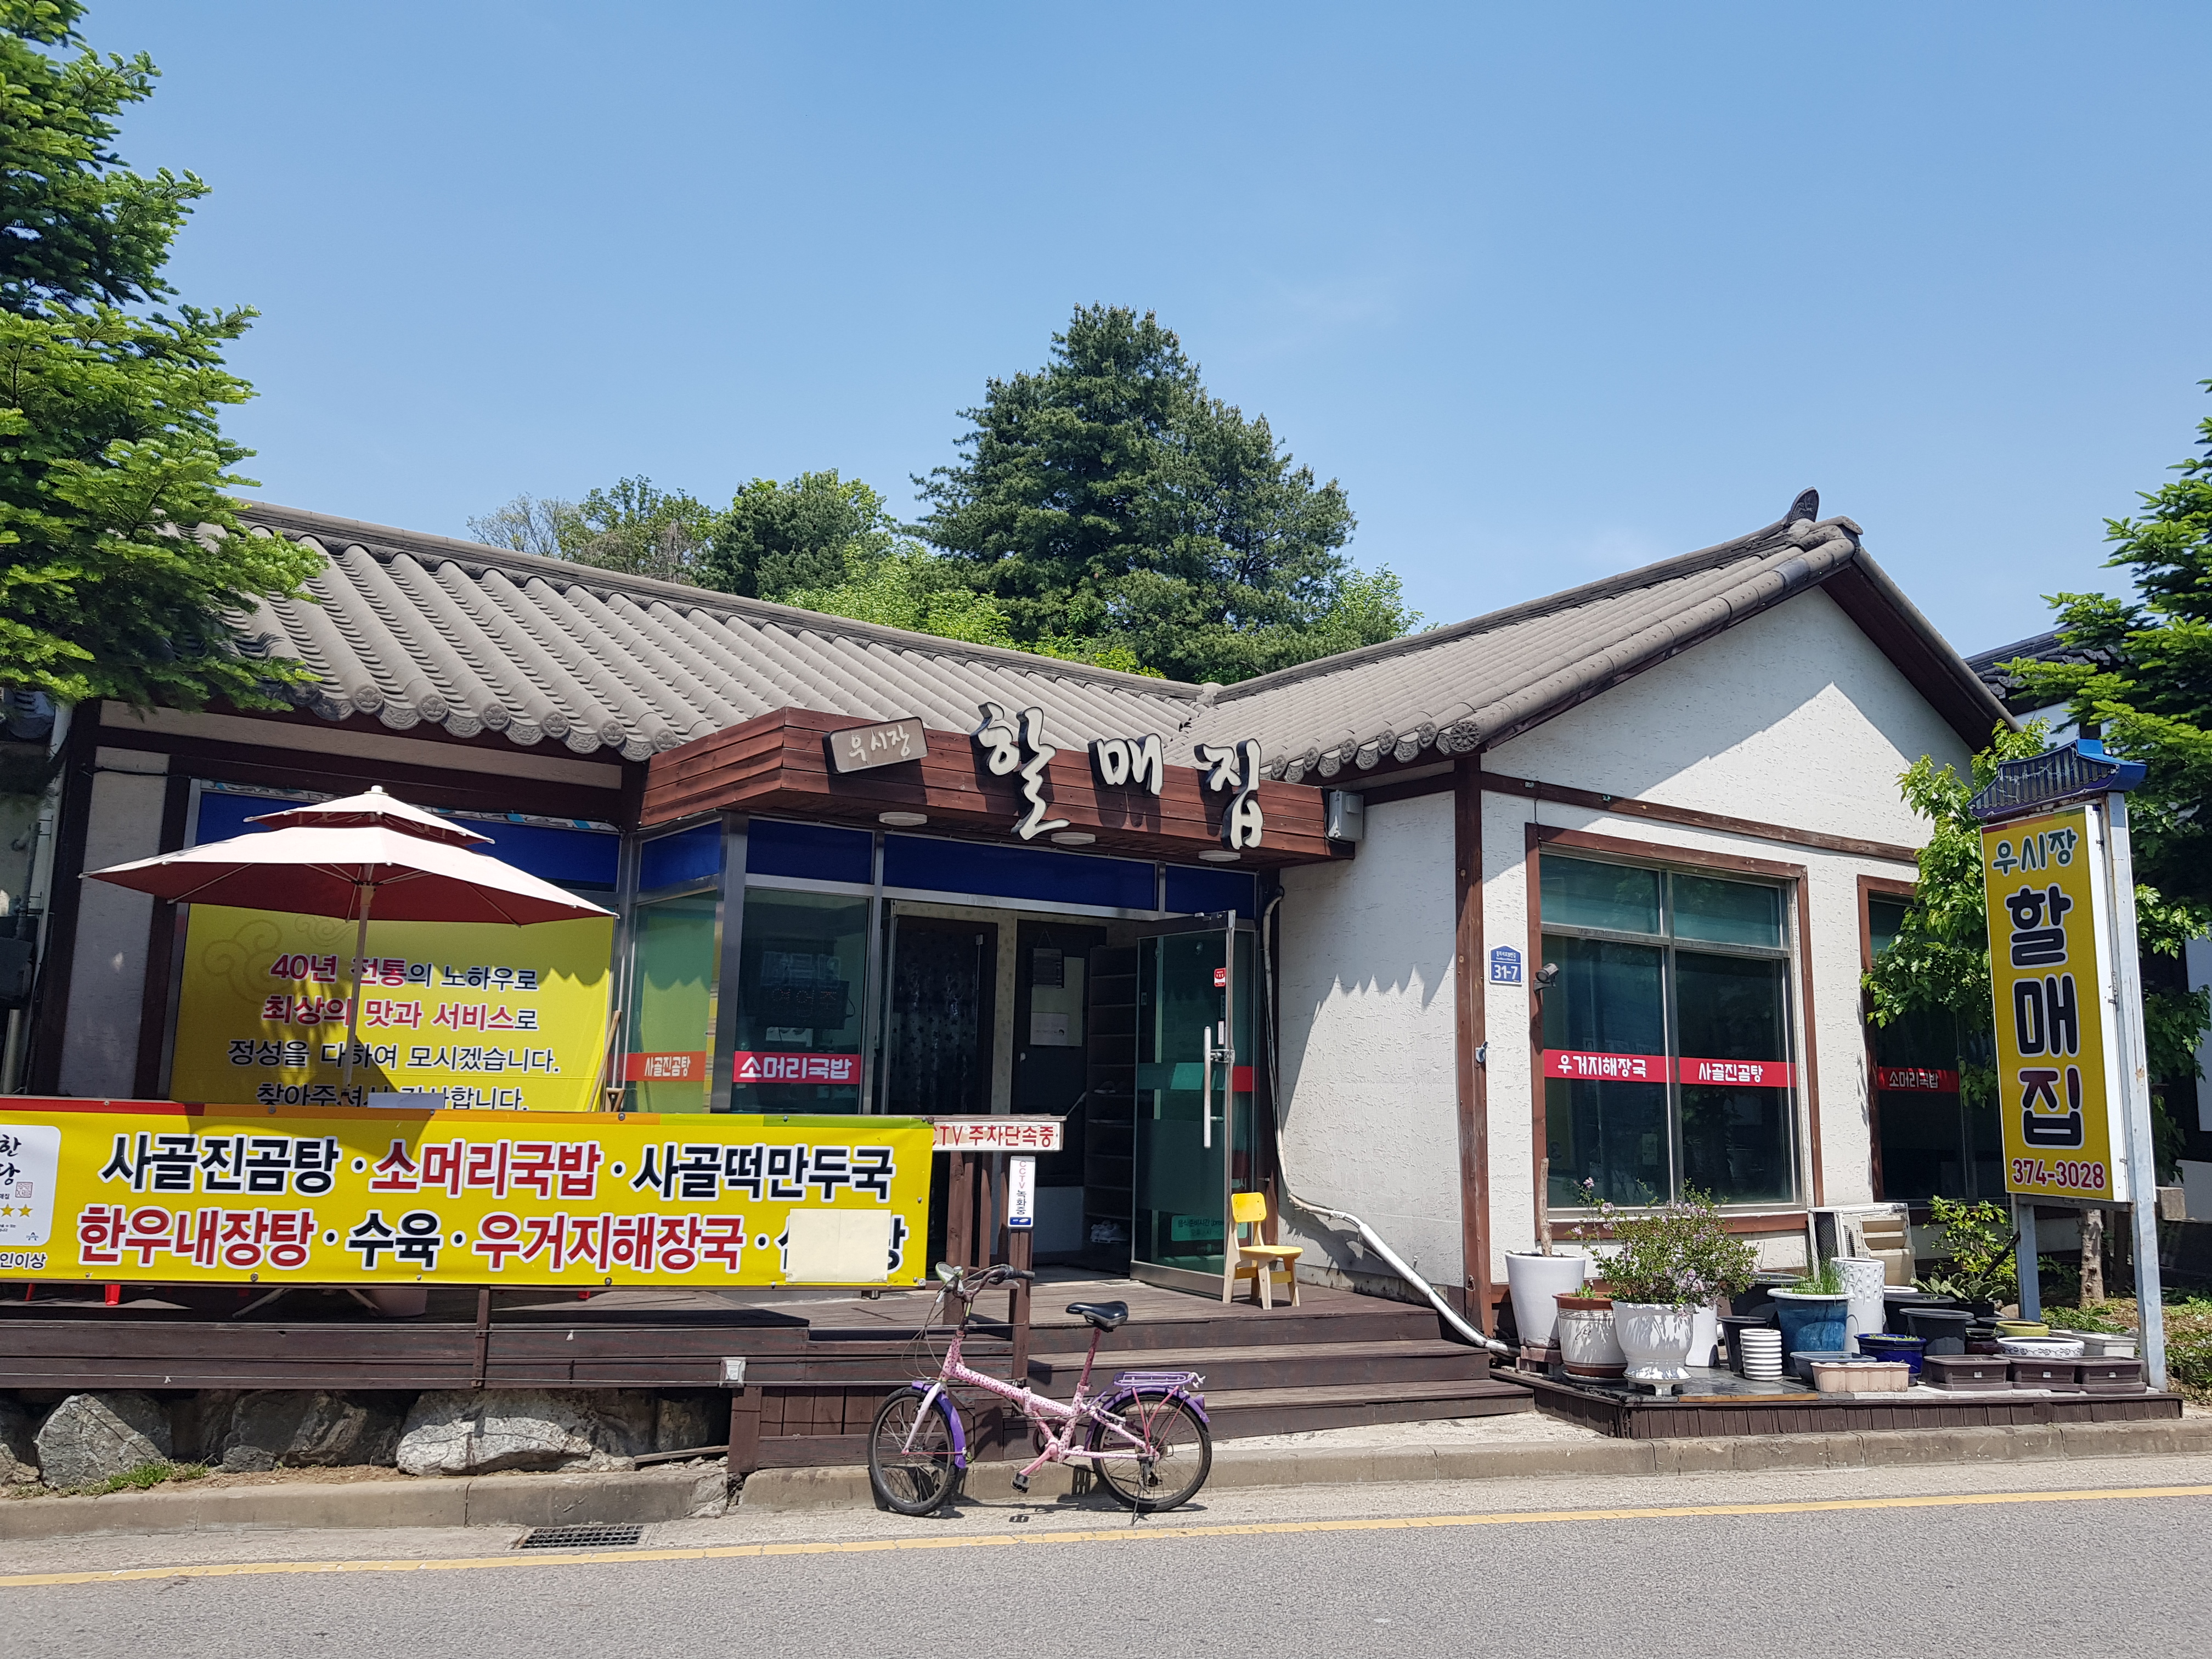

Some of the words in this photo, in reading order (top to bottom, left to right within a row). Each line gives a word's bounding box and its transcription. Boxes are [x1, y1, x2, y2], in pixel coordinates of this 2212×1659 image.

[848, 724, 912, 763] 우시장
[970, 702, 1265, 849] 할매집
[1992, 828, 2077, 874] 우시장
[270, 955, 337, 983] 40년
[441, 966, 538, 991] 노하우로
[1494, 964, 1518, 980] 31-7
[263, 995, 352, 1026] 최상의
[365, 1001, 422, 1029] 맛과
[433, 1003, 539, 1031] 서비스로
[2005, 884, 2083, 1148] 할매집
[228, 1040, 309, 1067] 정성을
[321, 1042, 397, 1069] 다하여
[408, 1047, 560, 1073] 모시겠습니다.
[644, 1056, 691, 1077] 사골진곰탕
[739, 1057, 853, 1080] 소머리국밥
[1558, 1054, 1647, 1079] 우거지해장국
[1698, 1062, 1764, 1084] 사골진곰탕
[1889, 1070, 1939, 1089] 소머리국밥
[968, 1125, 1054, 1148] 주차단속중
[101, 1133, 341, 1194] 사골진곰탕
[371, 1141, 601, 1198] 소머리국밥
[633, 1144, 896, 1202] 사골떡만두국
[1018, 1160, 1026, 1189] CCTV
[2012, 1159, 2106, 1190] 374-3028
[80, 1206, 315, 1268] 한우내장탕
[348, 1212, 441, 1269] 수육
[474, 1214, 746, 1273] 우거지해장국
